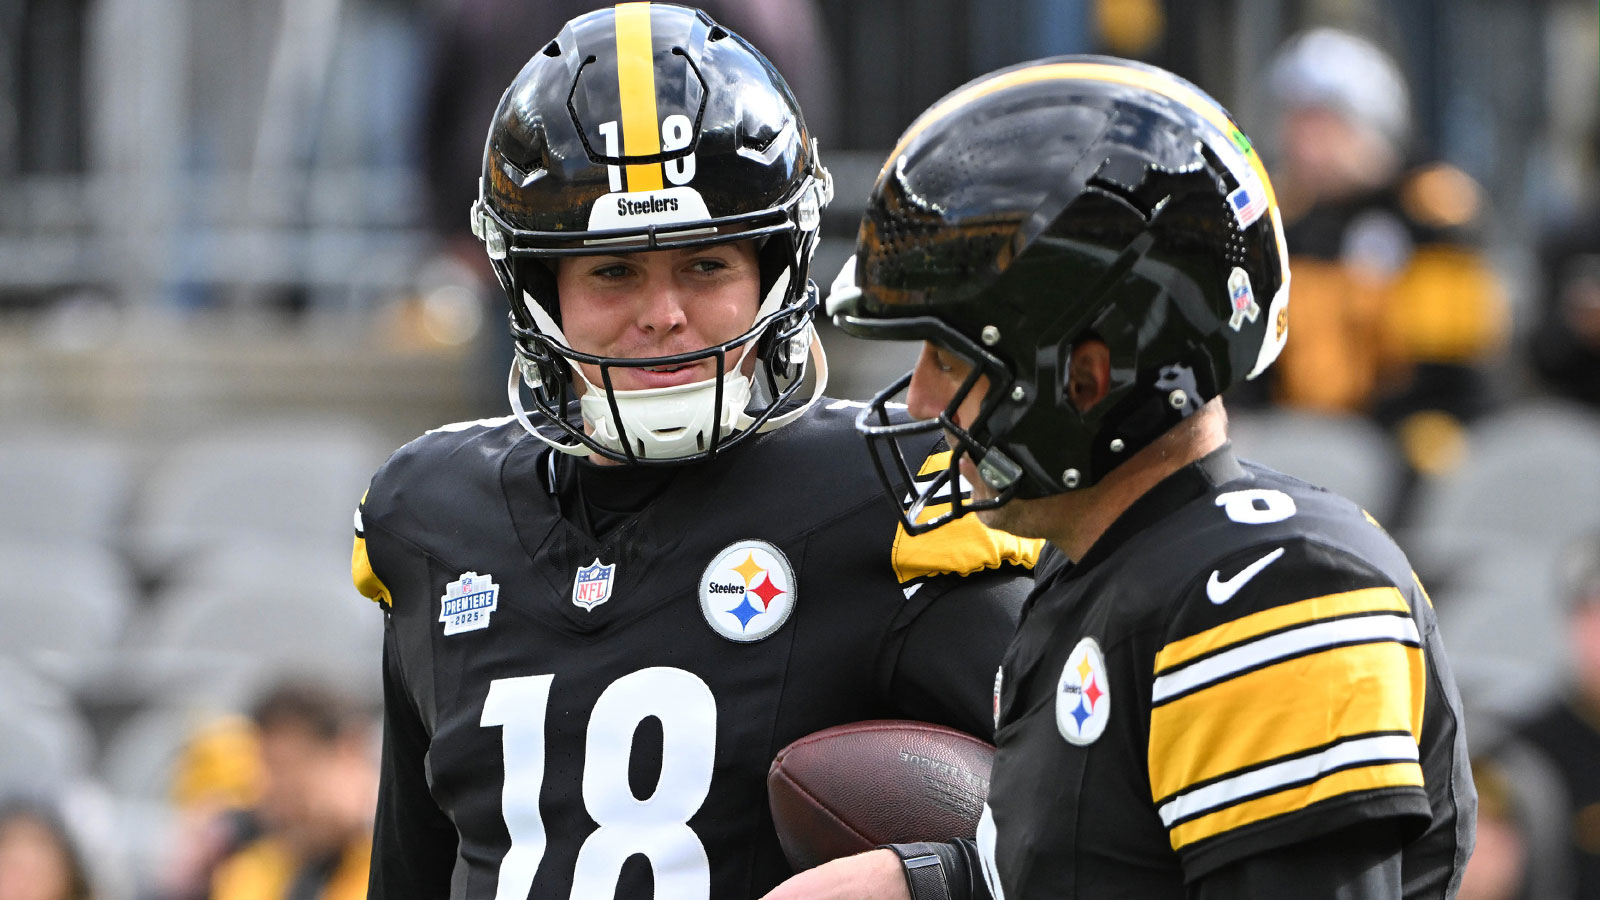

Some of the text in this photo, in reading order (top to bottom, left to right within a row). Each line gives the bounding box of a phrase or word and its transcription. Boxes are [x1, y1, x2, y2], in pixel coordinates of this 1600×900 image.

[617, 195, 679, 216] Steelers
[578, 582, 604, 602] NFL
[708, 581, 745, 594] Steelers
[479, 666, 717, 900] 18
